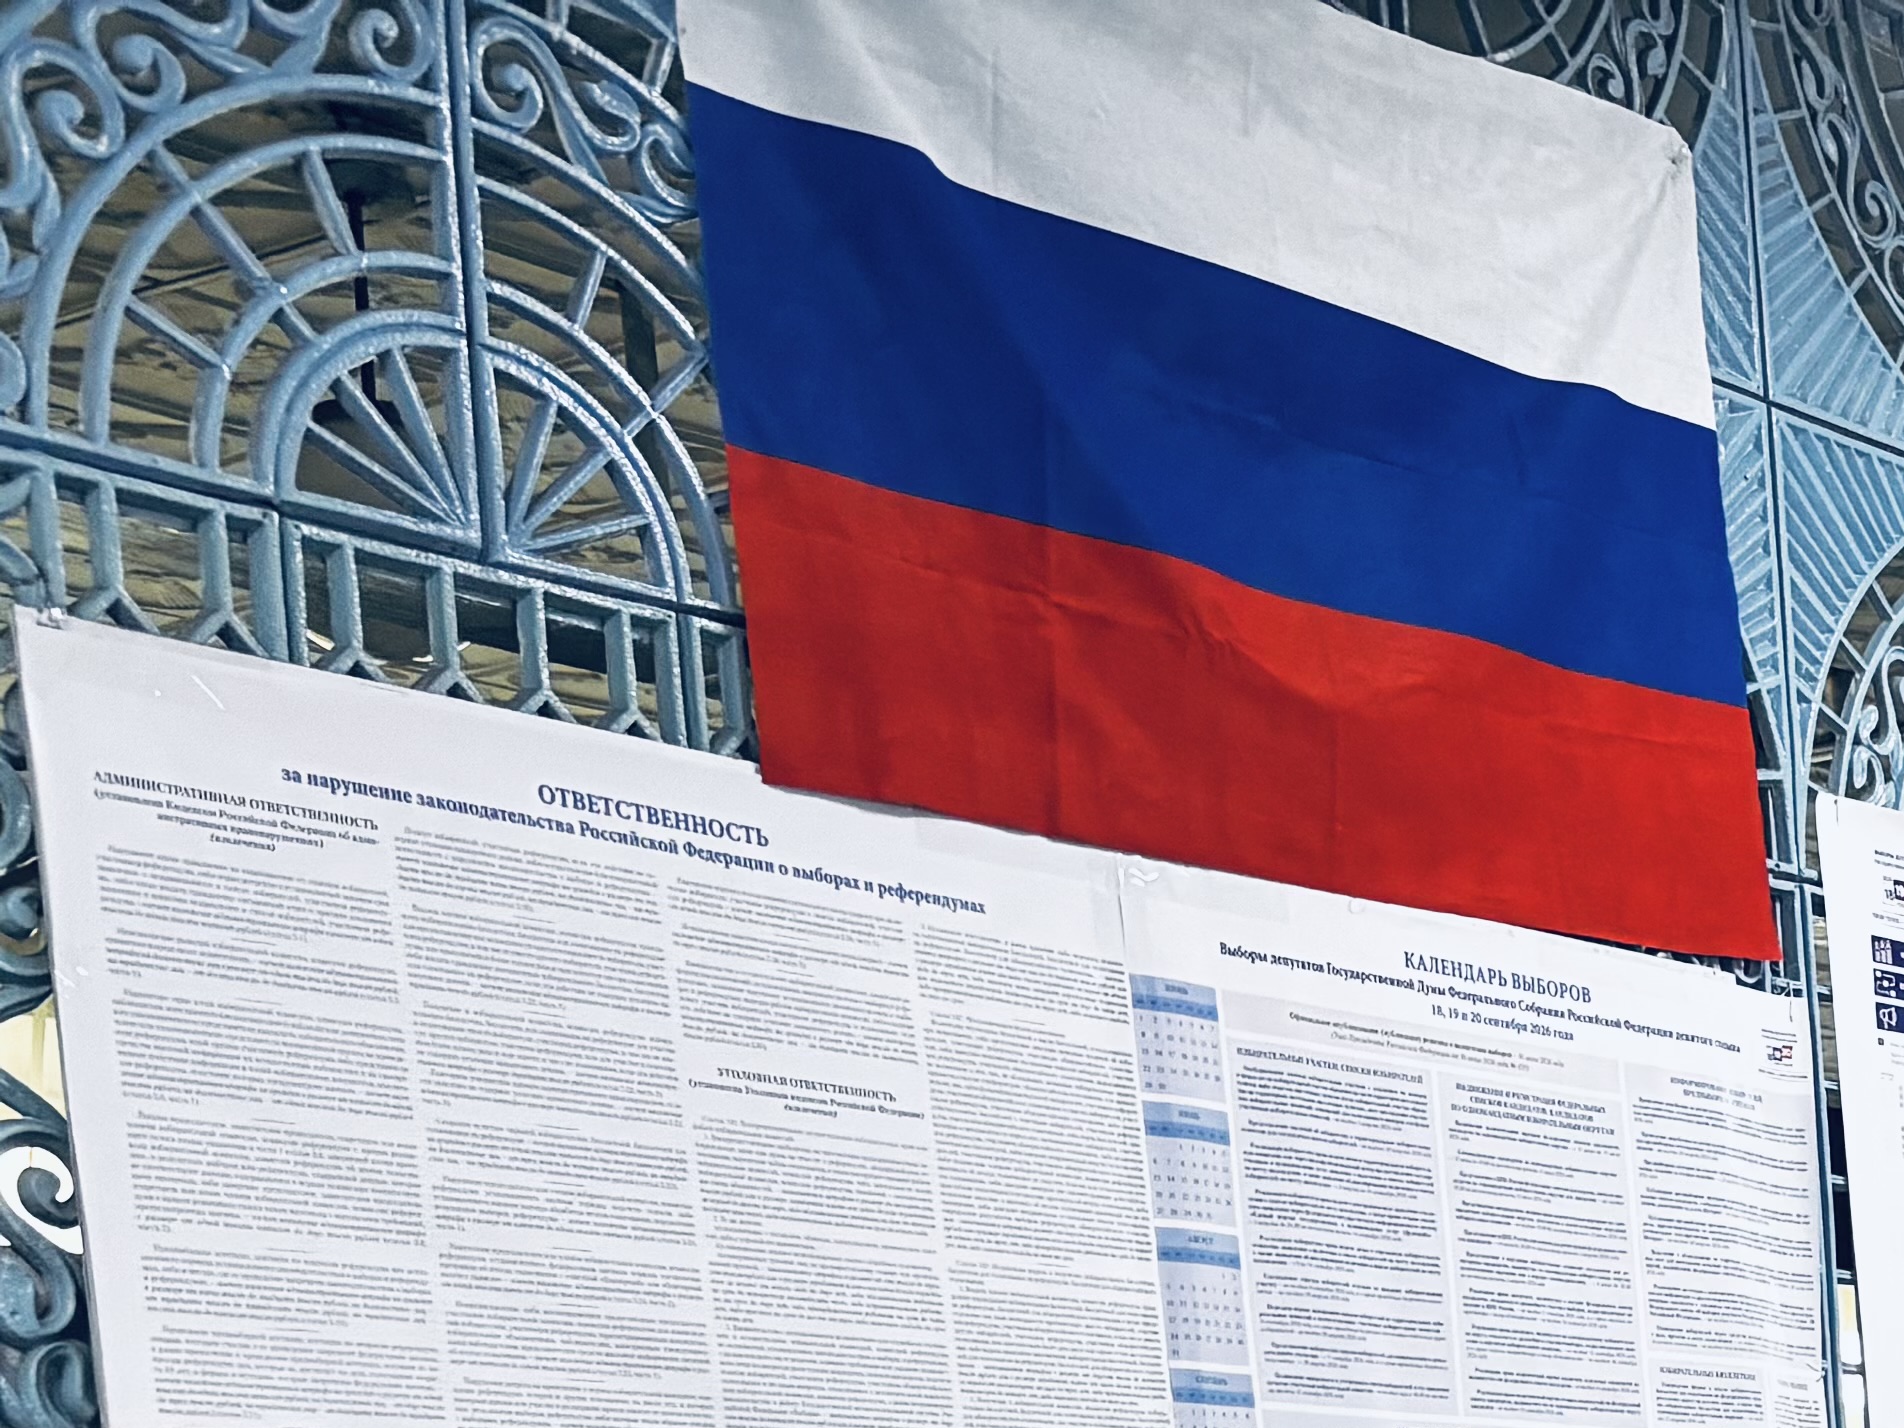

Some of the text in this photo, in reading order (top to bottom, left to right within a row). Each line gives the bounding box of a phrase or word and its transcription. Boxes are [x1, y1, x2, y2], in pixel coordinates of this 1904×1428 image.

[94, 771, 378, 830] АДМИНИСТРАТИВНАЯ ОТВЕТСТВЕННОСТЬ
[537, 784, 769, 847] ОТВЕТСТВЕННОСТЬ
[281, 768, 302, 784] за
[307, 773, 412, 804] нарушение
[416, 793, 575, 835] законодательства
[579, 820, 679, 855] Российской
[682, 841, 774, 873] Федерации
[792, 866, 860, 891] выборах
[877, 882, 986, 914] референдумах
[1219, 941, 1268, 964] Выборы
[1270, 954, 1325, 973] депутатов
[1326, 961, 1415, 990] Государственной
[1416, 979, 1446, 996] Думы
[1518, 999, 1565, 1018] Собрания
[1567, 1008, 1622, 1029] Российской
[1623, 1019, 1673, 1038] Федерации
[1403, 950, 1591, 1003] КАЛЕНДАРЬ ВЫБОРОВ
[1431, 1004, 1446, 1018] 18,
[1448, 1007, 1459, 1019] 19
[1470, 1011, 1482, 1024] 20
[1483, 1017, 1528, 1034] сентября
[1529, 1022, 1552, 1037] 2026
[1553, 1029, 1574, 1041] года
